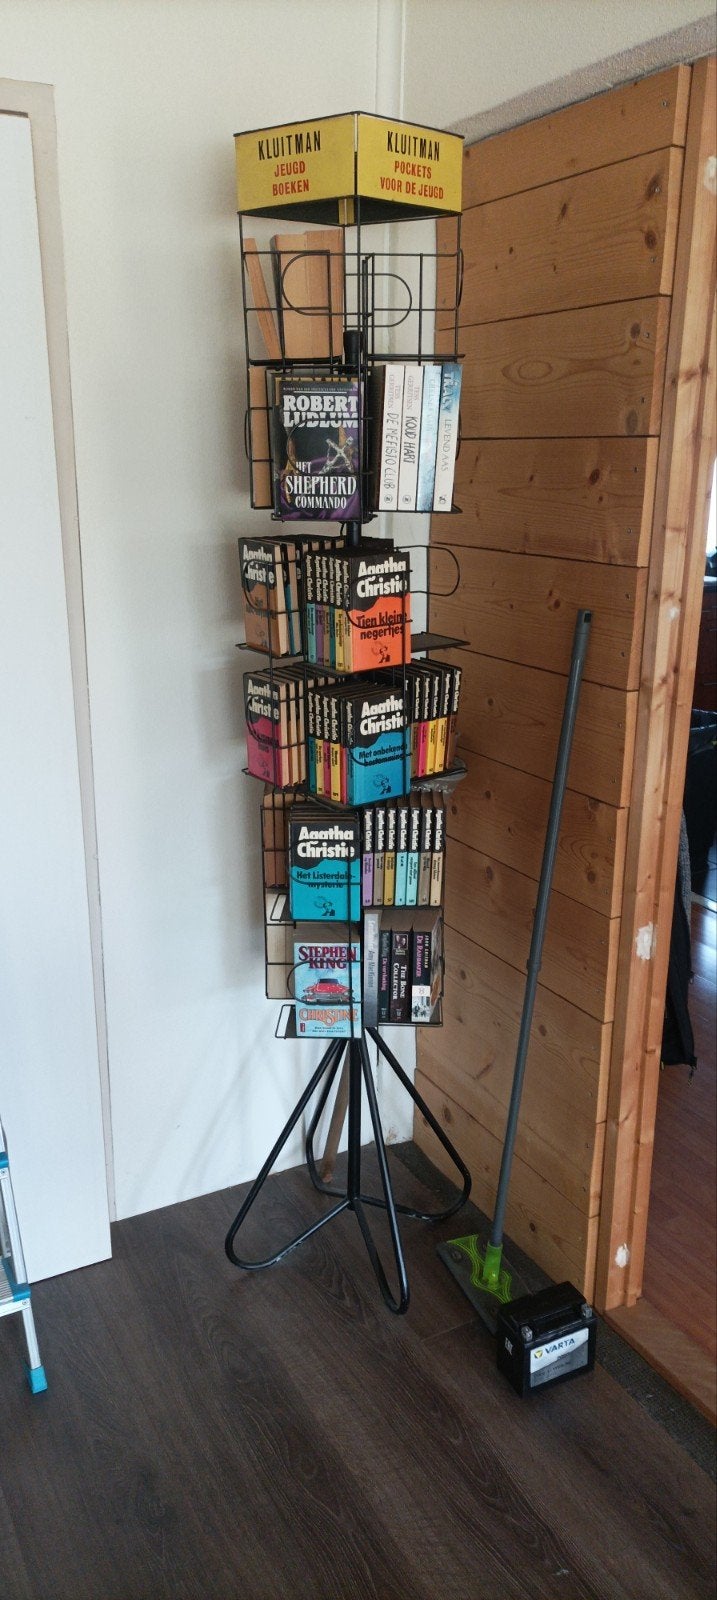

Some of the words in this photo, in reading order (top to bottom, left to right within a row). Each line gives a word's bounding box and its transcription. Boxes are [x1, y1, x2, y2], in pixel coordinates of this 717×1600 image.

[258, 131, 321, 160] KLUITMAN
[387, 131, 440, 162] KLUITMAN
[274, 161, 306, 177] JEUGD
[394, 160, 432, 179] POCKETS
[272, 179, 309, 196] BOEKEN
[380, 177, 402, 193] VOOR
[405, 182, 416, 195] DE
[418, 183, 444, 199] JEUGD
[283, 395, 358, 412] ROBERT
[283, 411, 358, 428] LUDLUM
[386, 412, 399, 425] DE
[405, 416, 418, 439] KOUD
[442, 419, 452, 452] LEVEND
[385, 428, 398, 465] MEFISTO
[403, 442, 416, 464] HART
[441, 453, 450, 472] AAS
[286, 475, 356, 495] SHEPHERD
[383, 468, 397, 490] CLUB
[295, 497, 347, 509] COMMANDO
[242, 561, 274, 584] Christe
[358, 556, 406, 577] Agatha
[356, 614, 377, 627] Tien
[247, 695, 279, 720] Christe
[298, 825, 354, 841] Agatha
[297, 840, 355, 858] Christie
[297, 871, 310, 880] Het
[298, 946, 356, 961] STEPHEN
[309, 957, 347, 969] KING
[545, 1338, 575, 1354] VARTA
